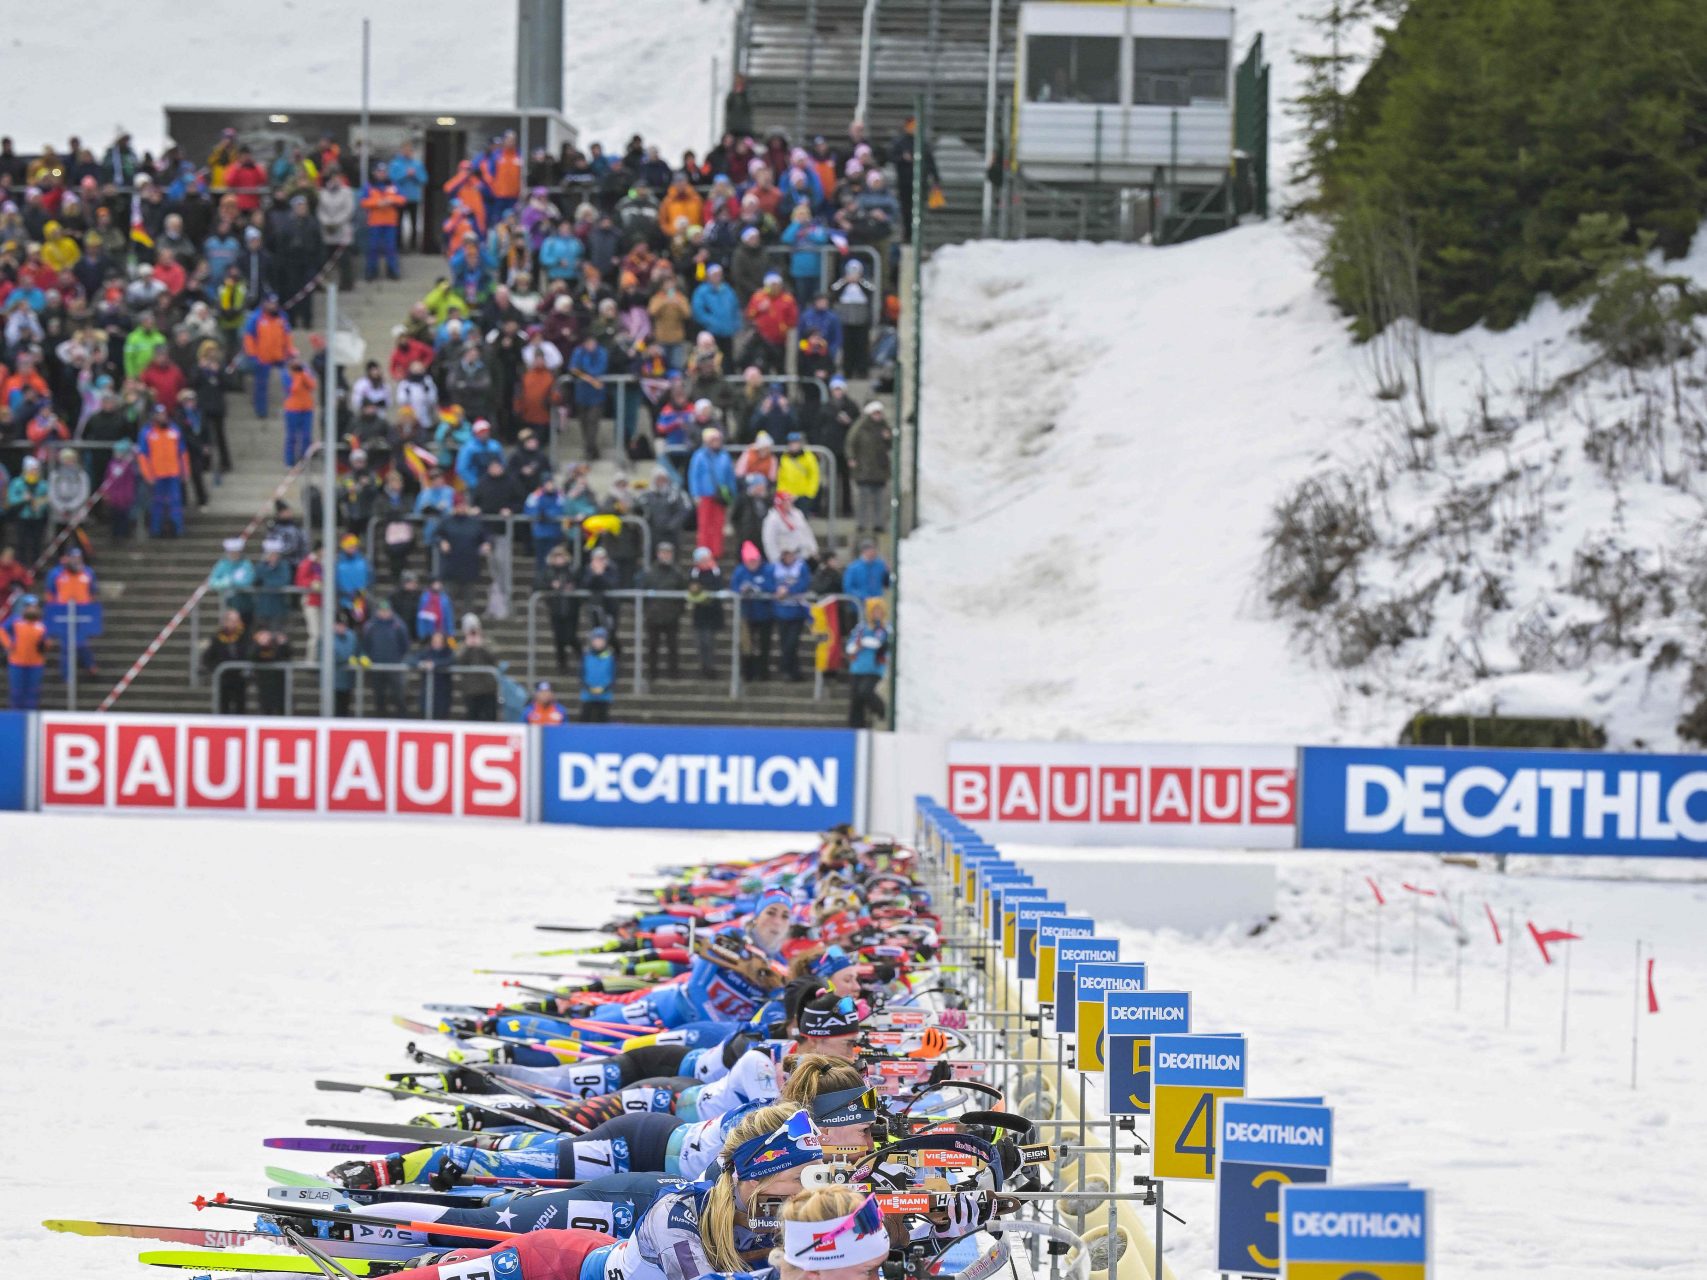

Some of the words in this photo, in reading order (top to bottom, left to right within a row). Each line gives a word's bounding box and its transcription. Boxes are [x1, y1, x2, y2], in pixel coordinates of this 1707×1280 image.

[53, 733, 517, 807] BAUHAUS
[559, 752, 838, 808] DECATHLON
[954, 770, 1292, 818] BAUHAUS
[1346, 763, 1707, 843] DECATHLO
[1042, 926, 1093, 937] DECATHLON
[1061, 949, 1116, 962] DECATHLON
[1080, 977, 1141, 991] DECATHLON
[1111, 1006, 1184, 1021] DECATHLON
[1158, 1053, 1240, 1071] DECATHLON
[1174, 1092, 1216, 1175] 4
[1225, 1122, 1323, 1146] DECATHLON
[925, 1151, 972, 1163] VIESSMANN
[877, 1196, 928, 1209] VIESSMANN
[1292, 1212, 1421, 1237] DECATHLON
